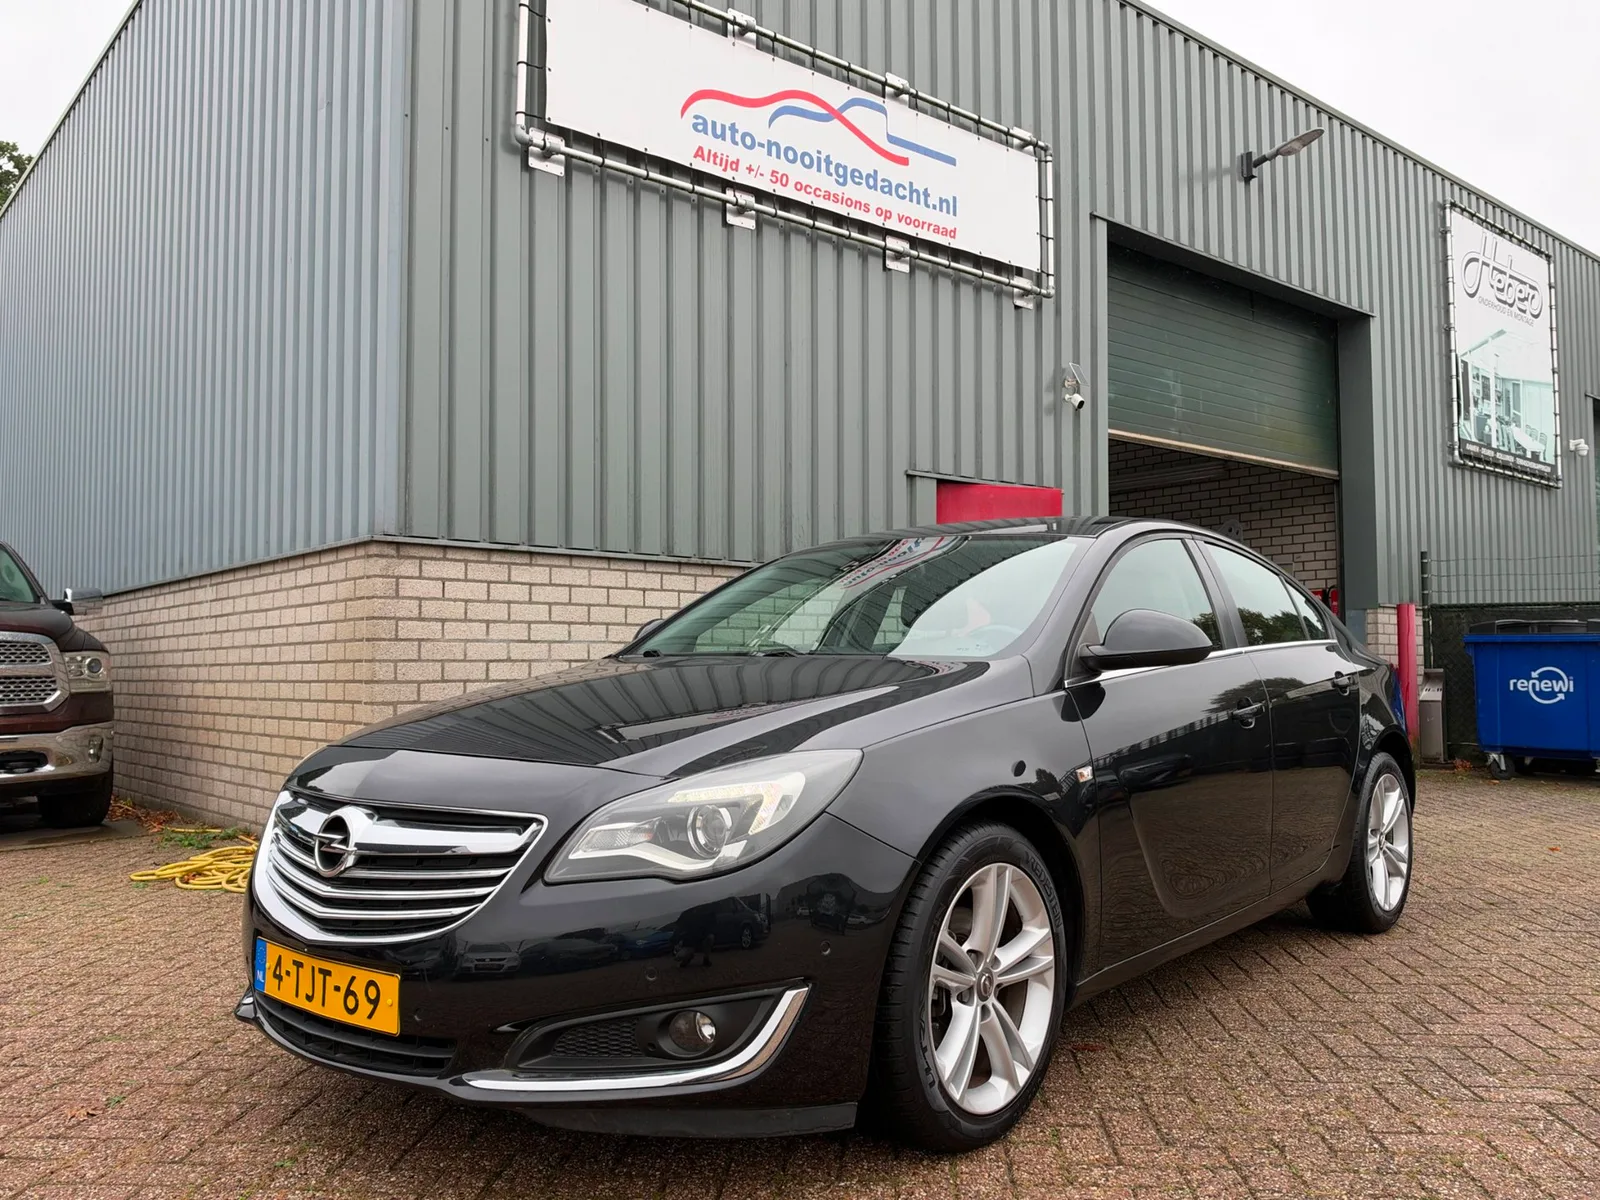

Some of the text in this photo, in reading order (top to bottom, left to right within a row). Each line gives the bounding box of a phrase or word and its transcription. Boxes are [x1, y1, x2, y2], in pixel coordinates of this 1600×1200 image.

[691, 114, 957, 217] auto-nooitgedacht.nl
[693, 145, 957, 240] Altijd +/- 50 occasions op voorraad
[1478, 296, 1535, 328] ONDERHOUD EN MONTAGE
[1509, 675, 1574, 693] renewi
[256, 969, 265, 983] NL
[272, 954, 381, 1020] 4-TJT-69
